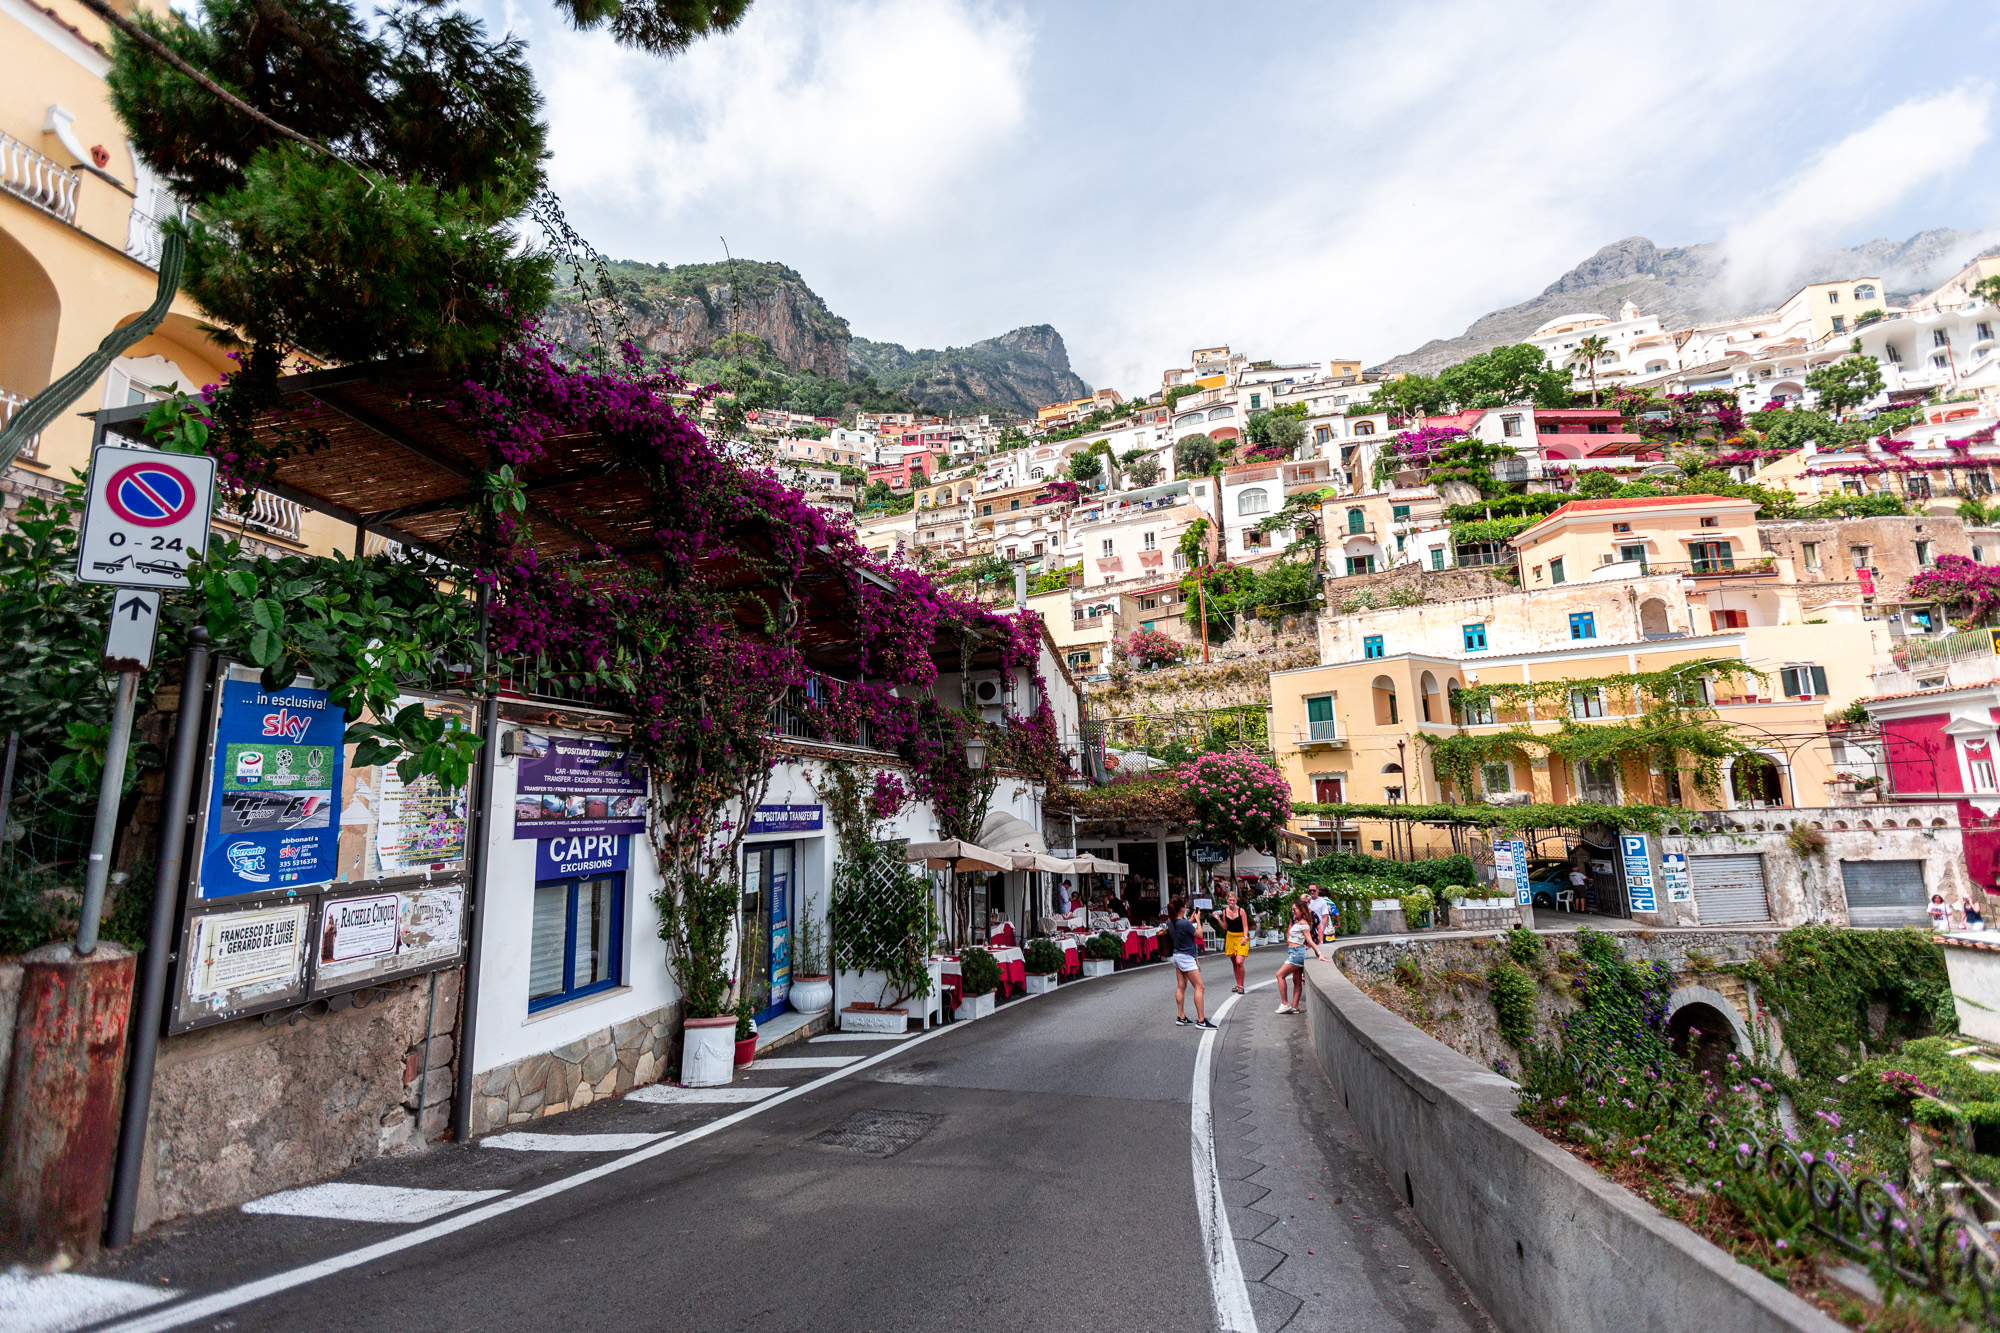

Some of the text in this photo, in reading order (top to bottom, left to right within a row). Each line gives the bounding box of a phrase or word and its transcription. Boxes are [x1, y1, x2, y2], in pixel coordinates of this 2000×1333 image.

[150, 536, 183, 552] 24
[256, 692, 268, 705] in
[271, 695, 327, 710] esclusiva!
[262, 708, 312, 744] sky
[563, 747, 590, 756] POSITANO
[247, 776, 259, 784] TIM
[303, 775, 326, 783] EUROPA
[569, 768, 589, 776] MINIVAN
[605, 770, 622, 778] DRIVER
[606, 777, 618, 785] TOUR
[763, 811, 813, 821] POSITANO TRANSFER
[281, 836, 314, 844] abbonati
[1625, 838, 1641, 855] P
[229, 846, 267, 857] Sorrento
[279, 844, 301, 860] sky
[550, 834, 618, 862] CAPRI
[233, 856, 266, 873] Sat
[279, 858, 318, 868] 335 5316378
[560, 859, 612, 873] EXCURSIONS
[1521, 891, 1528, 903] P
[341, 903, 395, 928] RACHELE CINQUE
[220, 920, 296, 943] FRANCESCO DE LUISE
[227, 938, 262, 954] GERARDO
[263, 936, 272, 948] DE
[273, 932, 294, 946] LUISE
